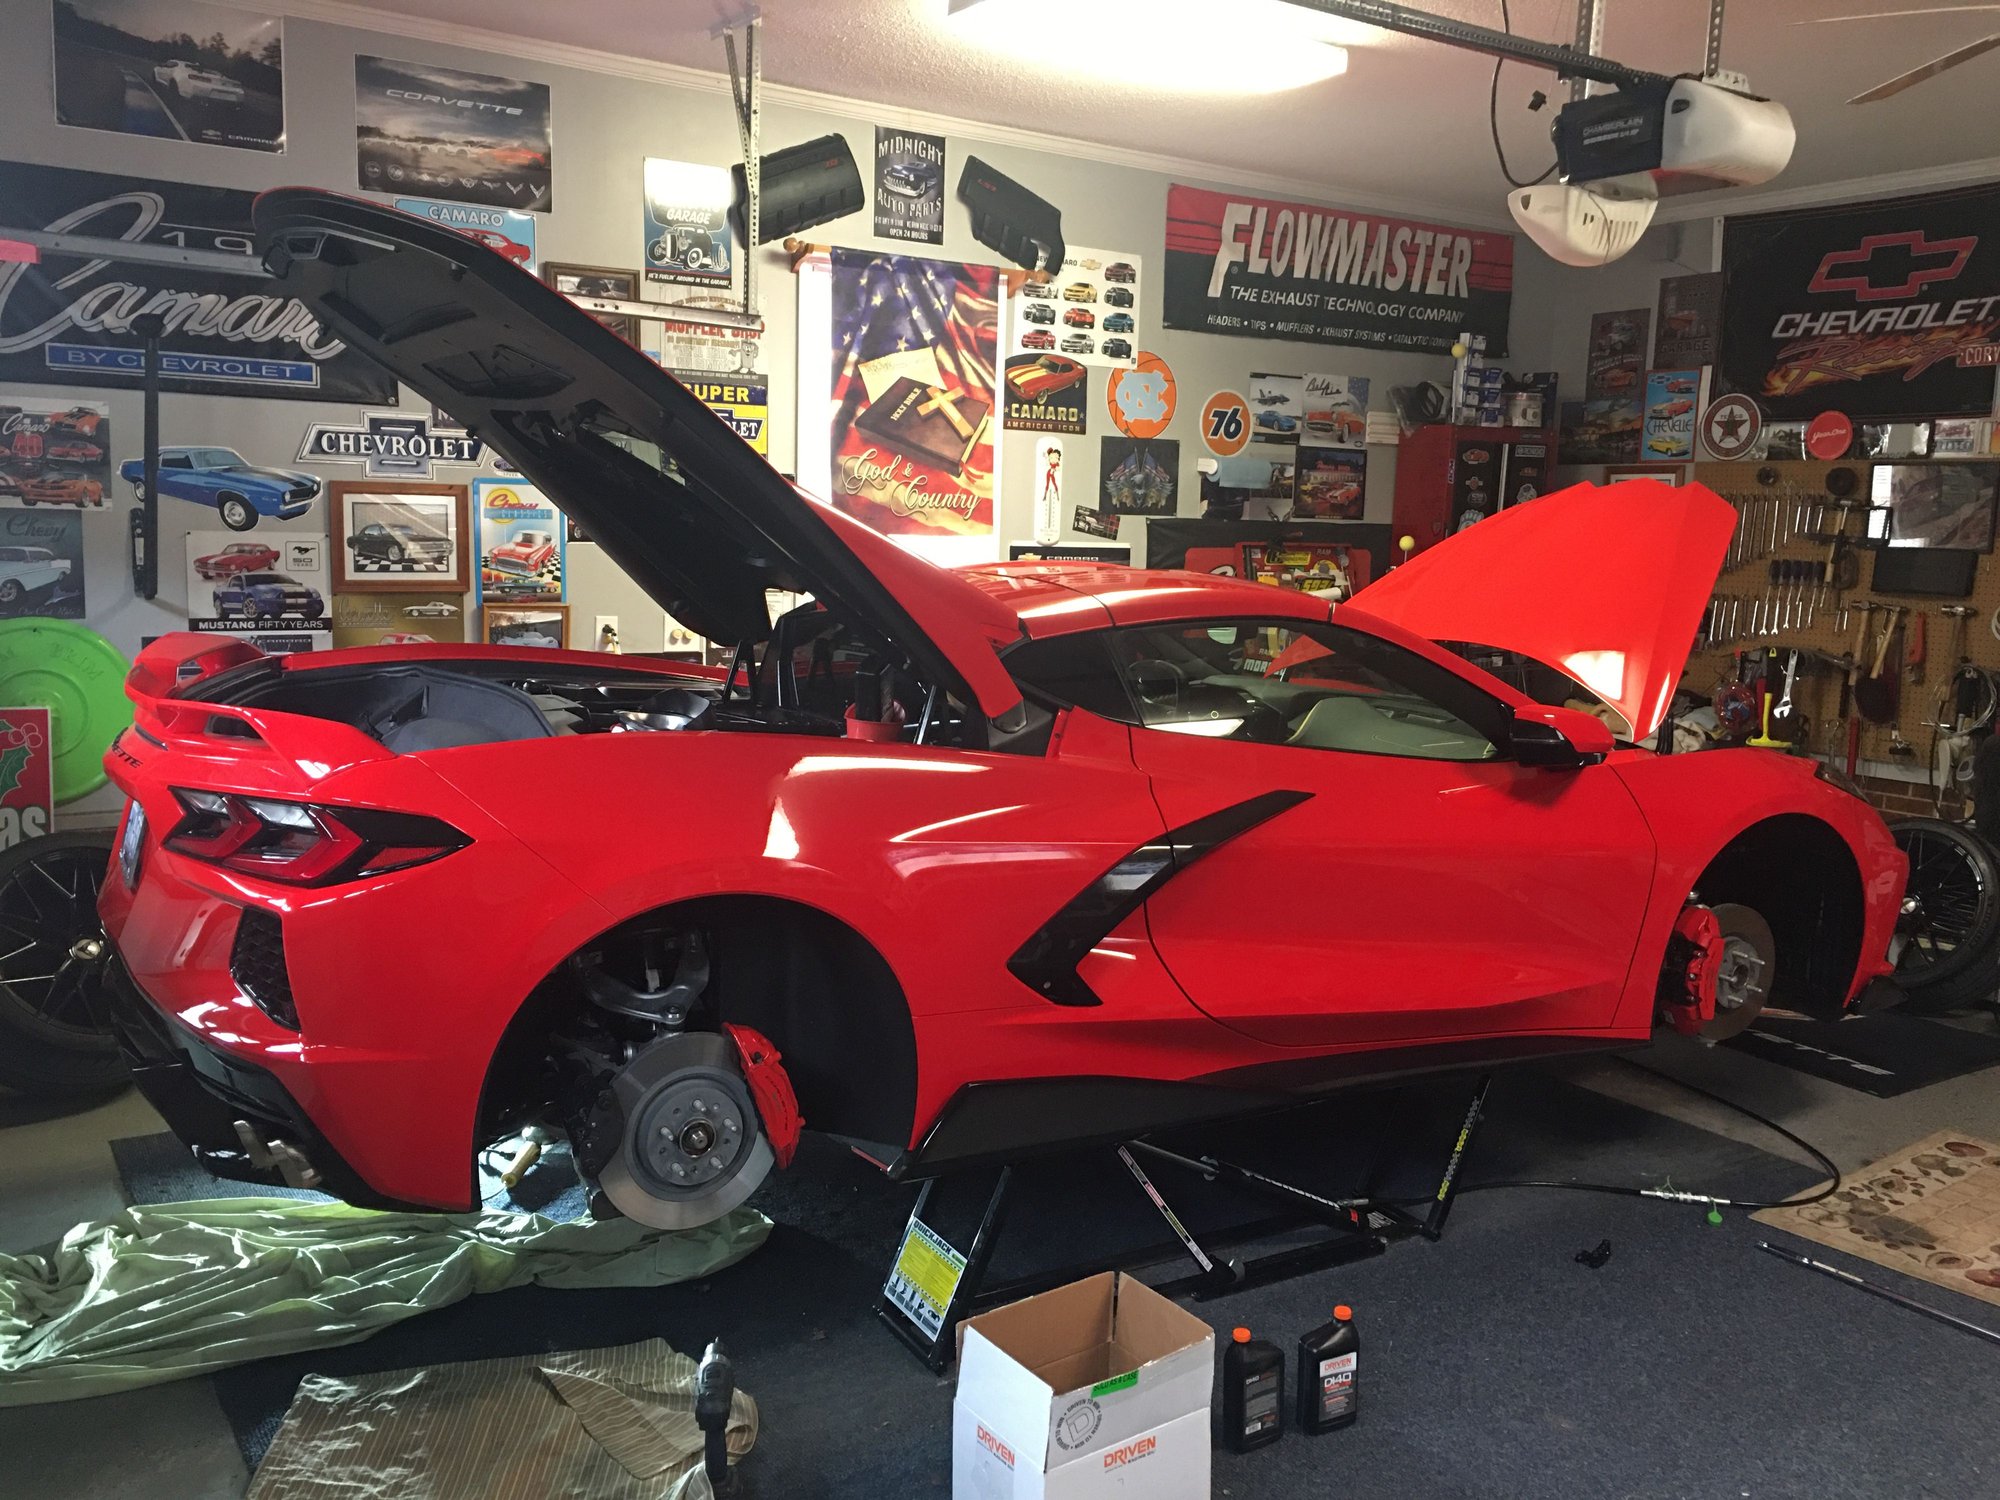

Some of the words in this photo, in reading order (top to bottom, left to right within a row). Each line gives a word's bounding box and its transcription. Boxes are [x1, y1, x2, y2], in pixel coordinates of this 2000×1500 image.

[386, 88, 523, 116] CORVETTE
[878, 136, 943, 166] MIDNIGHT
[428, 205, 504, 227] CAMARO
[666, 207, 712, 225] GARAGE
[877, 188, 904, 215] AUTO
[909, 197, 941, 218] PARTS
[889, 227, 903, 237] OPEN
[903, 229, 911, 238] 24
[911, 230, 929, 240] HOURS
[1207, 202, 1473, 299] FLOWMASTER
[1230, 285, 1258, 302] THE
[1261, 289, 1320, 308] EXHAUST
[1322, 296, 1406, 318] TECHNOOGY
[1408, 306, 1465, 323] COMPANY
[1771, 295, 2000, 339] CHEVROLET
[1207, 314, 1241, 328] HEADERS
[1250, 319, 1267, 331] TIPS
[1276, 321, 1315, 335] MUFFLERS
[1354, 328, 1387, 342] SYSTEMS
[67, 351, 102, 364] BY
[1776, 332, 1990, 395] Racing
[890, 403, 908, 421] HOLY
[903, 387, 922, 406] BIBLE
[1011, 403, 1078, 422] CAMARO
[2, 412, 51, 435] Camaro
[1006, 420, 1053, 430] AMERICAN
[1207, 405, 1243, 442] 76
[1646, 419, 1694, 436] CHEVELLE
[321, 432, 474, 460] CHEVROLET
[842, 448, 902, 495] God
[902, 462, 913, 477] &
[890, 475, 982, 521] Country
[7, 514, 68, 542] Chevy
[199, 621, 255, 630] MUSTANG
[258, 620, 287, 629] FIFTY
[289, 620, 323, 629] YEARS
[913, 1220, 953, 1255] QUICKJACK
[1324, 1357, 1352, 1371] DRIVEN
[1324, 1372, 1352, 1388] DI40
[1066, 1399, 1086, 1412] DRIVEN
[977, 1424, 1015, 1467] DRIVEN
[1104, 1435, 1156, 1468] DRIVEN
